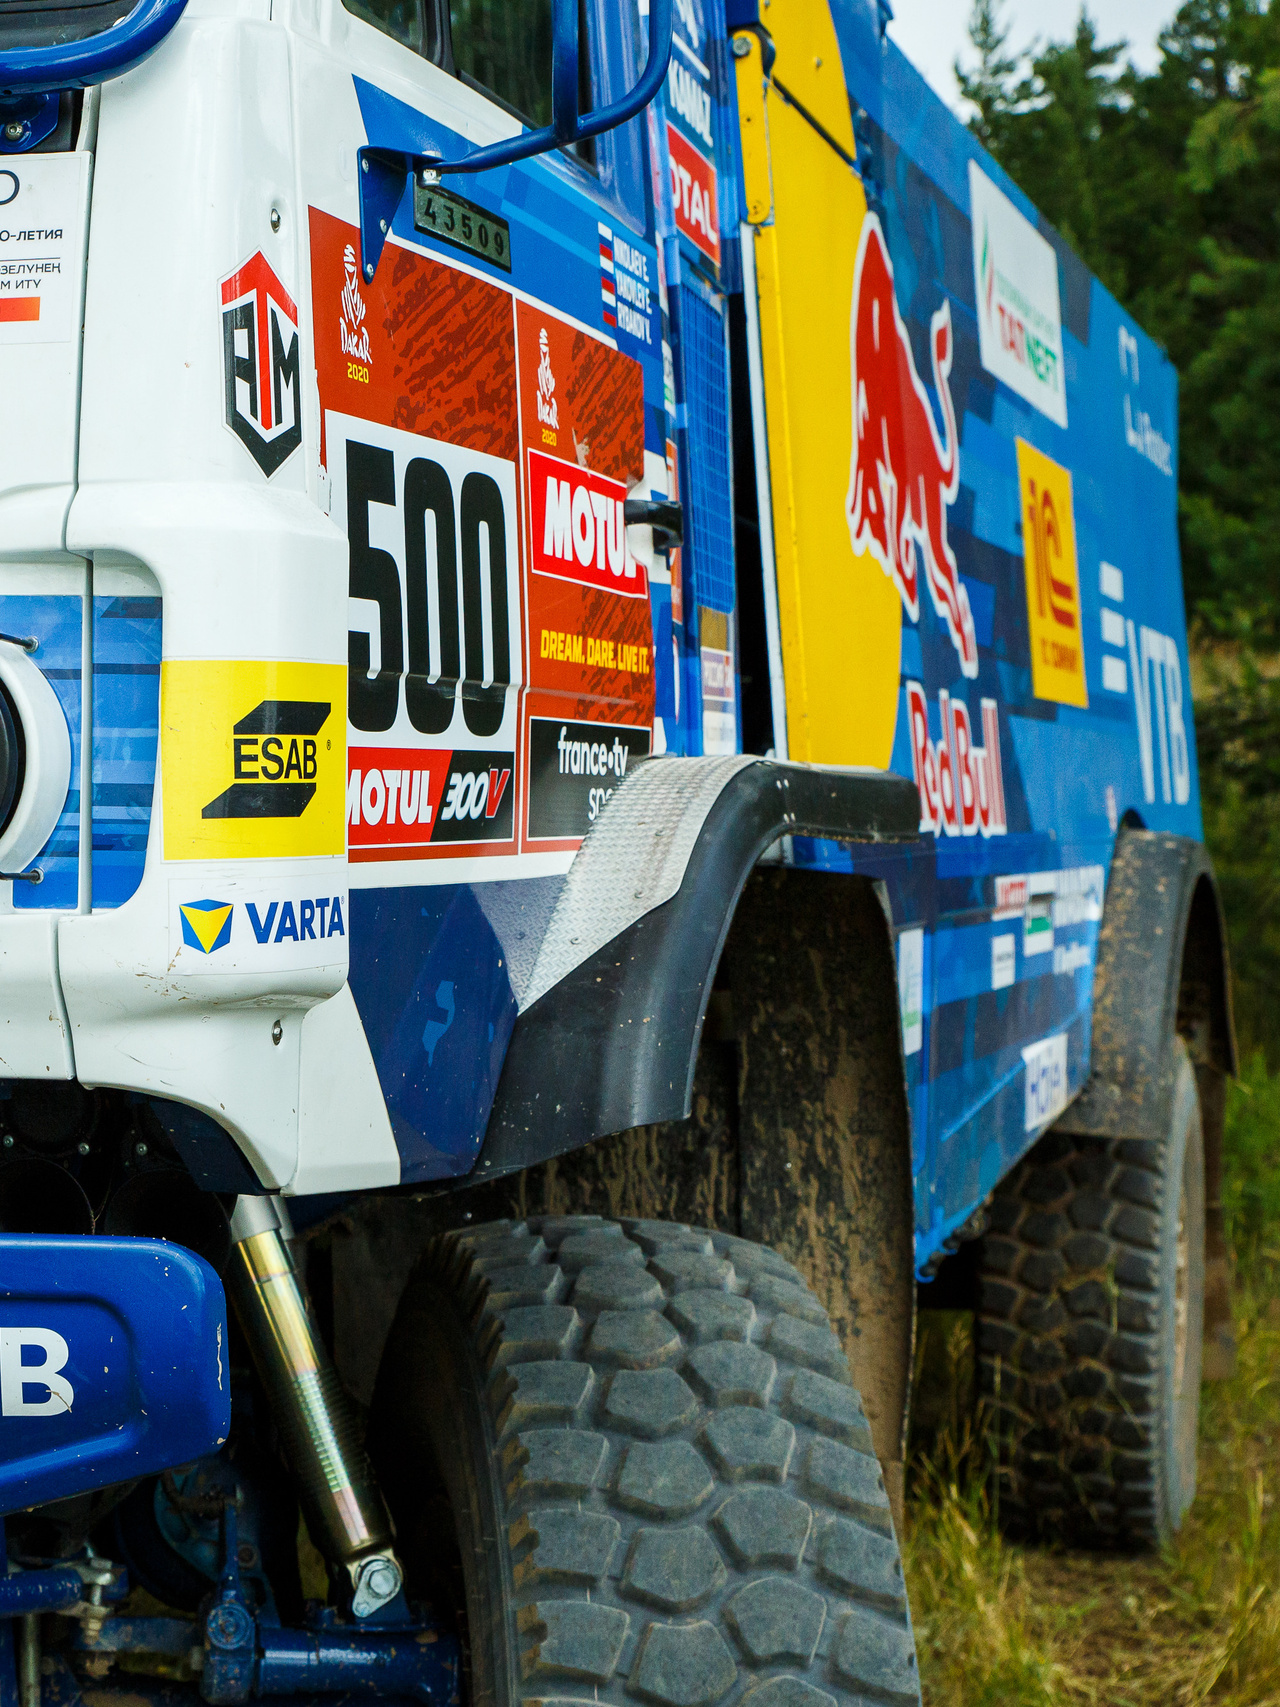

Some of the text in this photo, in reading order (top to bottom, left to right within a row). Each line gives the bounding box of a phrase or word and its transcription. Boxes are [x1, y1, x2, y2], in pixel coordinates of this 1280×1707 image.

[669, 153, 717, 246] OTAL
[424, 197, 504, 257] 43509
[339, 316, 373, 365] DAKAR
[347, 362, 370, 384] 2020
[541, 428, 558, 447] 2020
[345, 437, 513, 738] 500
[540, 629, 585, 665] DREAM.
[586, 637, 617, 669] DARE.
[617, 643, 638, 674] LIVE
[1126, 618, 1190, 805] VTB
[232, 736, 318, 781] ESAB
[906, 680, 1008, 839] Red Bull
[440, 767, 512, 822] 300V
[244, 895, 346, 945] VARTA
